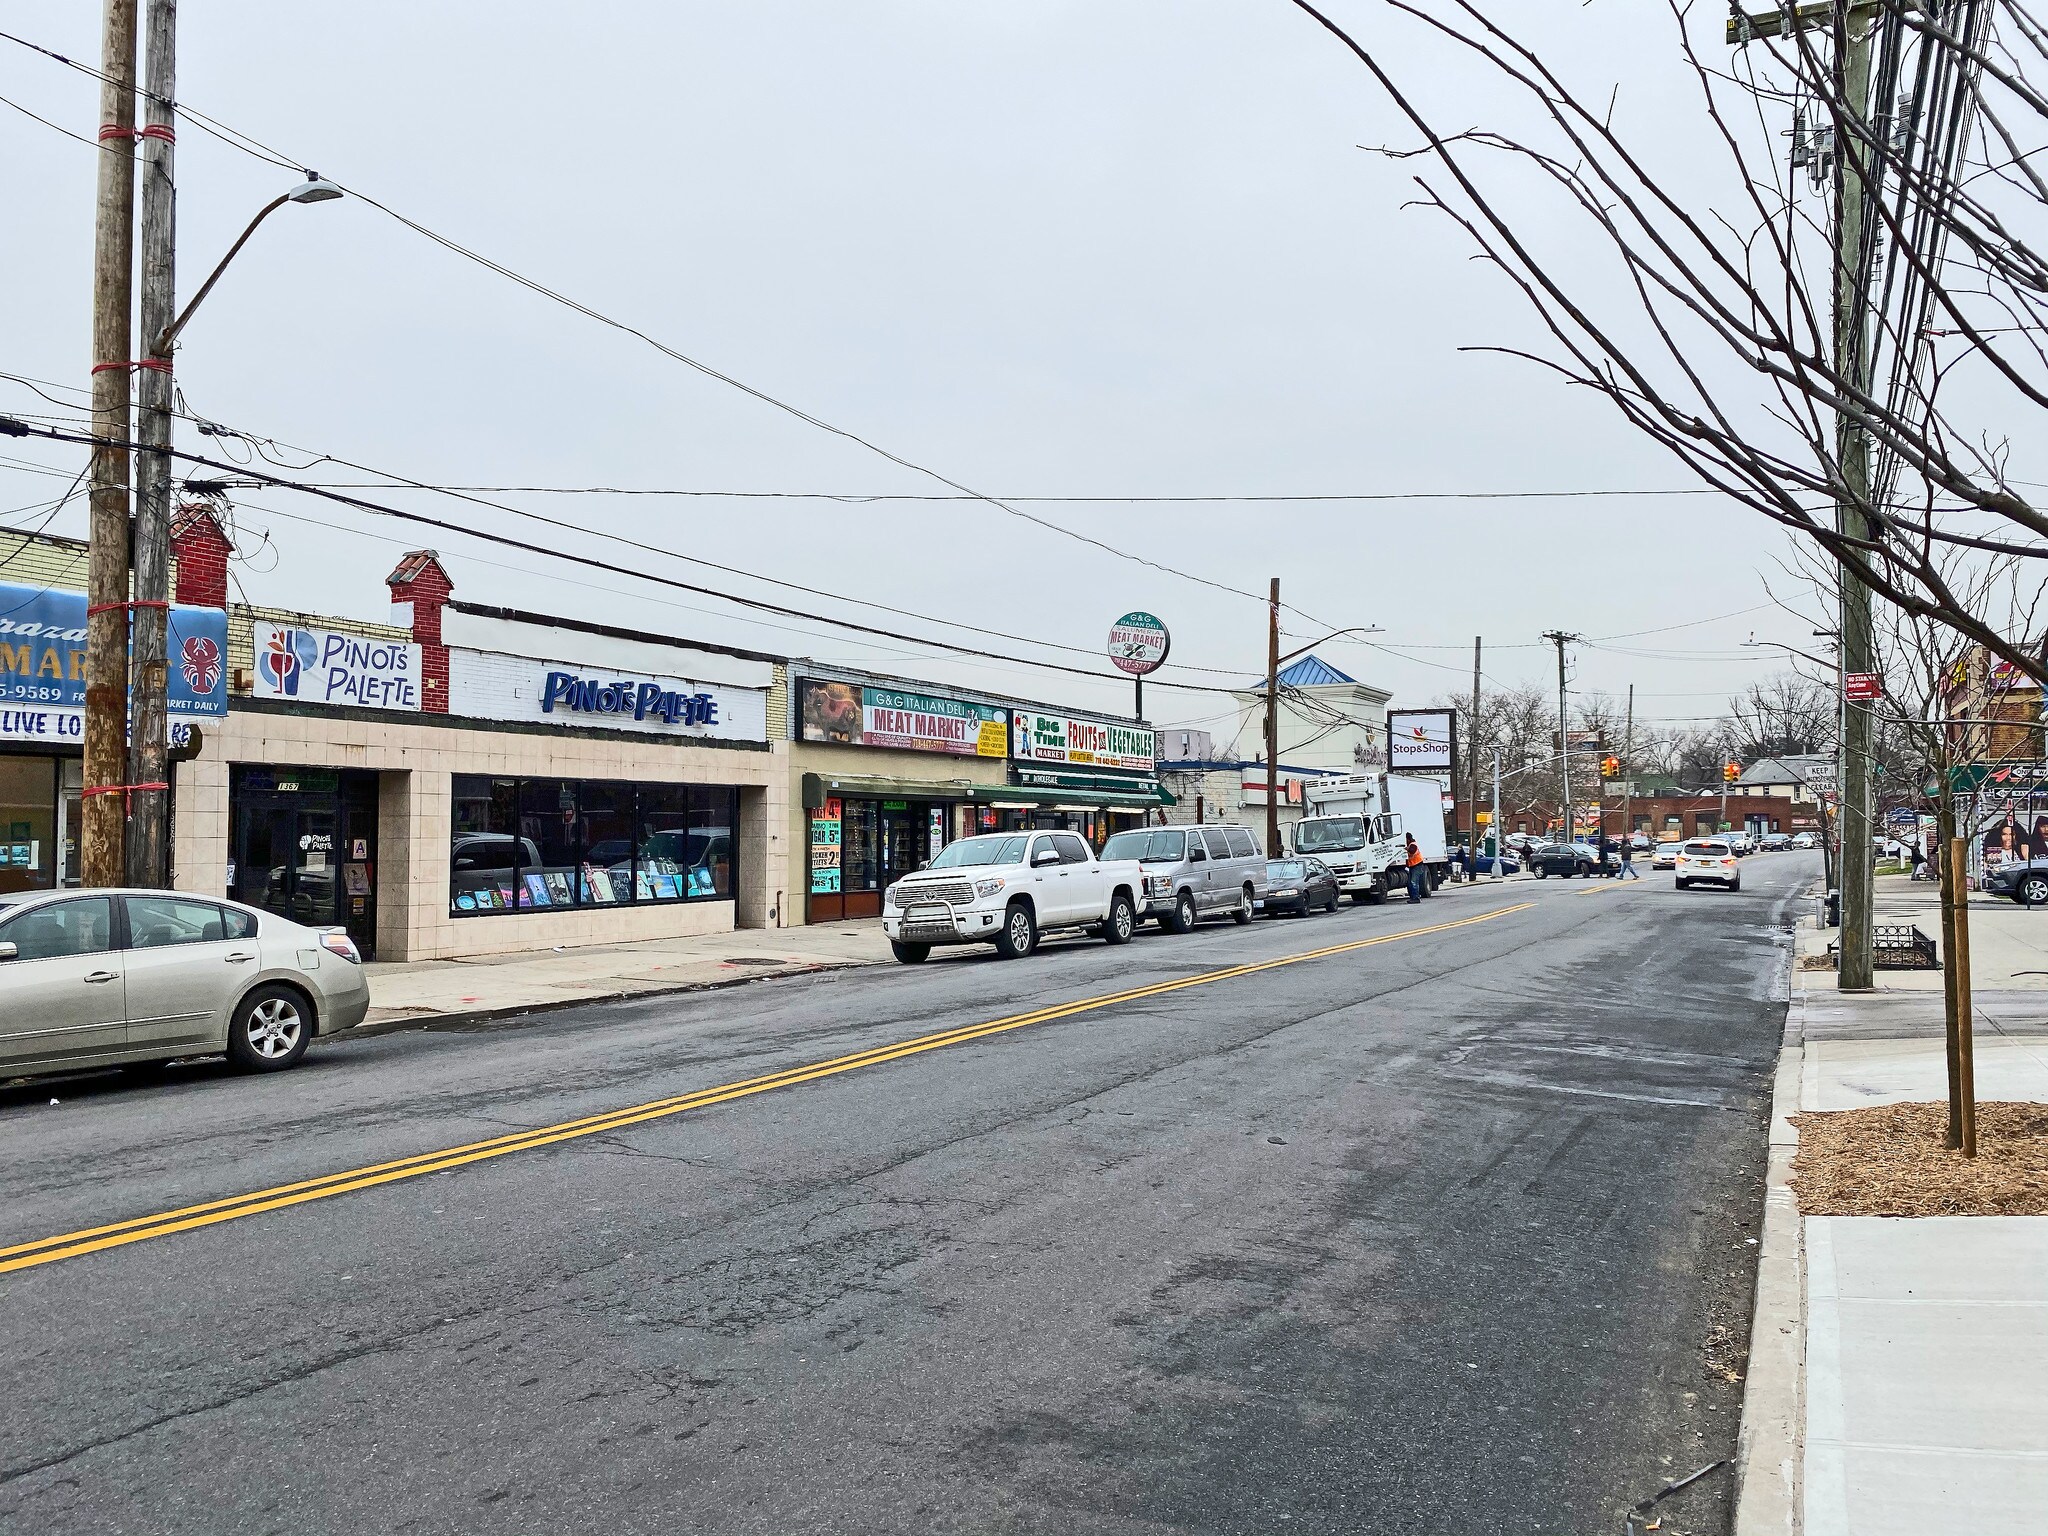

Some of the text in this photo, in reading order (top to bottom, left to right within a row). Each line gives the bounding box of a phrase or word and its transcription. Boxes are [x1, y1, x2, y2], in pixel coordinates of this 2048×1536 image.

[1130, 614, 1151, 622] G&G
[1116, 626, 1161, 635] SALUMERIA
[1110, 631, 1164, 650] MEAT MARKET
[325, 667, 416, 706] PALETTE
[167, 700, 219, 711] RKET DAILY
[634, 683, 719, 727] PALETTE
[876, 693, 904, 707] G&G
[906, 697, 945, 713] ITALIAN
[946, 703, 965, 716] DELI
[3, 711, 47, 733] LIVE
[874, 708, 913, 734] MEAT
[915, 713, 967, 740] MARKET
[1034, 731, 1066, 747] TIME
[1068, 720, 1097, 752] FRUITS
[1106, 726, 1152, 757] VEGETABLES
[1036, 748, 1064, 759] MARKET
[1393, 743, 1449, 755] Stop&Shop
[1811, 767, 1829, 775] KEEP
[356, 841, 365, 853] A
